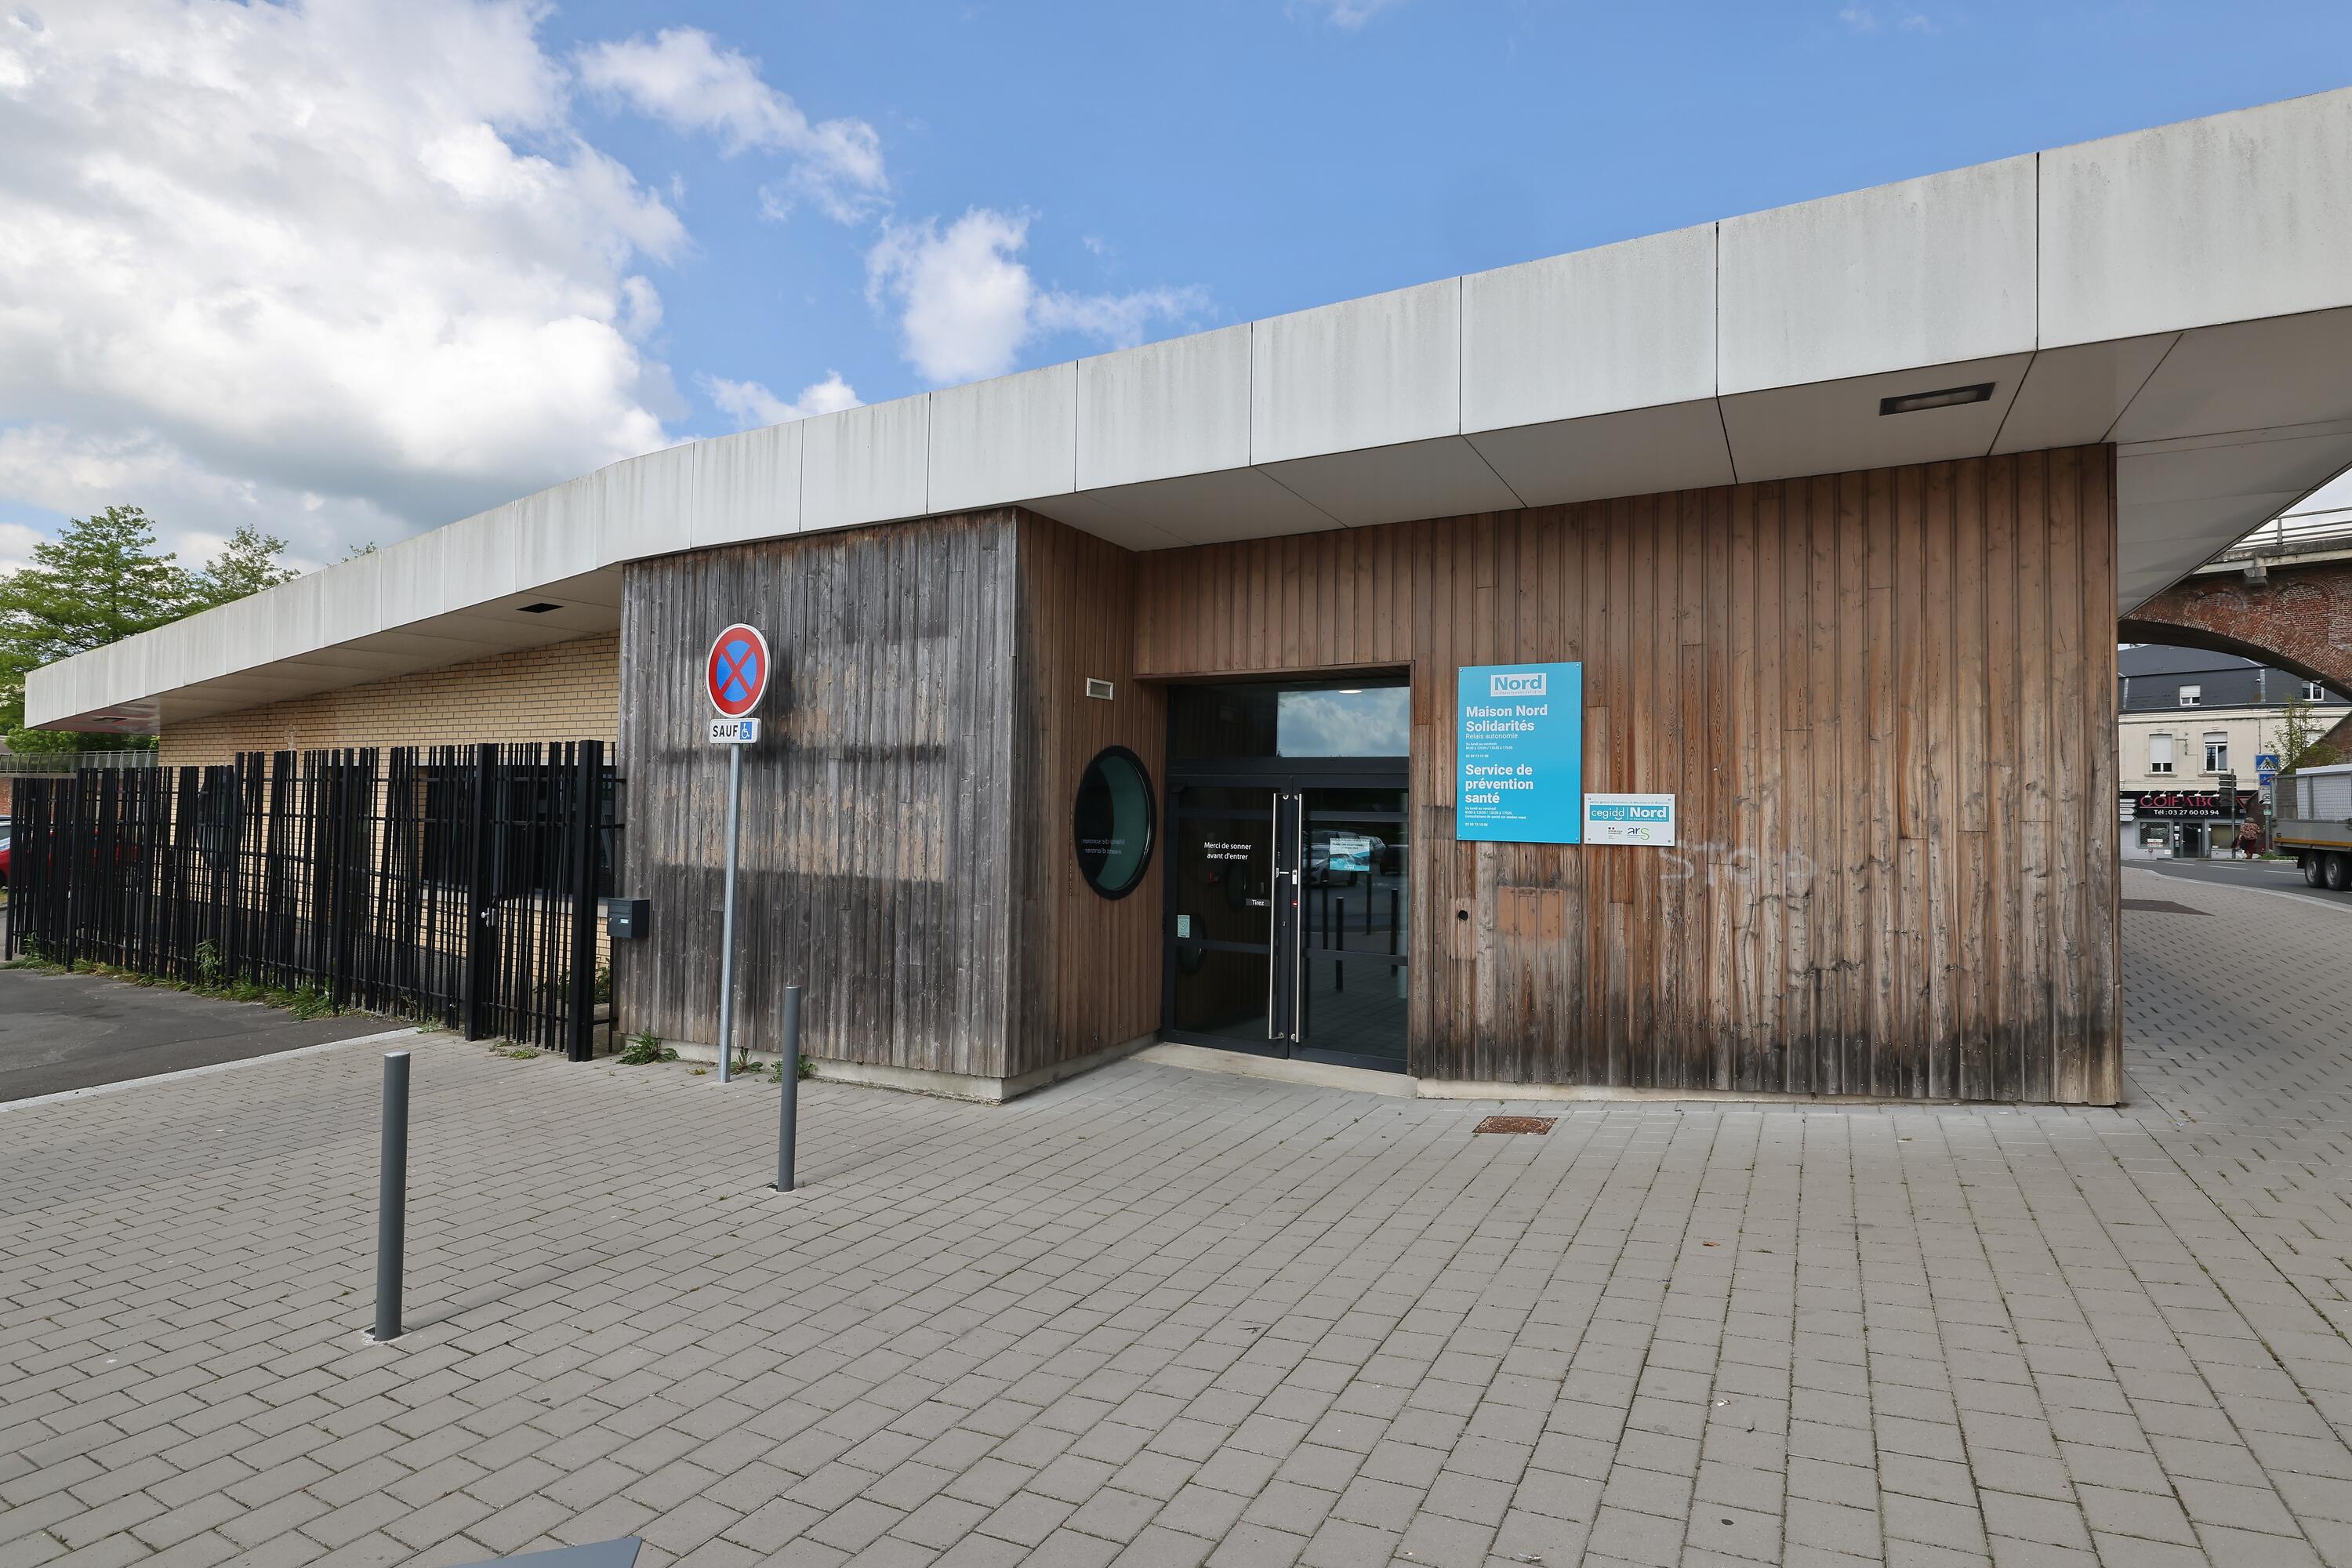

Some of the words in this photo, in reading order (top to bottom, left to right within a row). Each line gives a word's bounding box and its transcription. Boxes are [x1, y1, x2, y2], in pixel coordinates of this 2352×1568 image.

[1494, 674, 1542, 691] Nord
[1466, 706, 1512, 717] Maison
[1515, 704, 1548, 717] Nord
[713, 725, 739, 737] SAUF
[1466, 720, 1535, 732] Solidarités
[1465, 764, 1513, 775] Service
[1516, 763, 1533, 775] de
[1465, 778, 1534, 792] prévention
[1465, 792, 1500, 804] santé
[1591, 807, 1625, 820] cegidd
[1630, 807, 1667, 818] Nord
